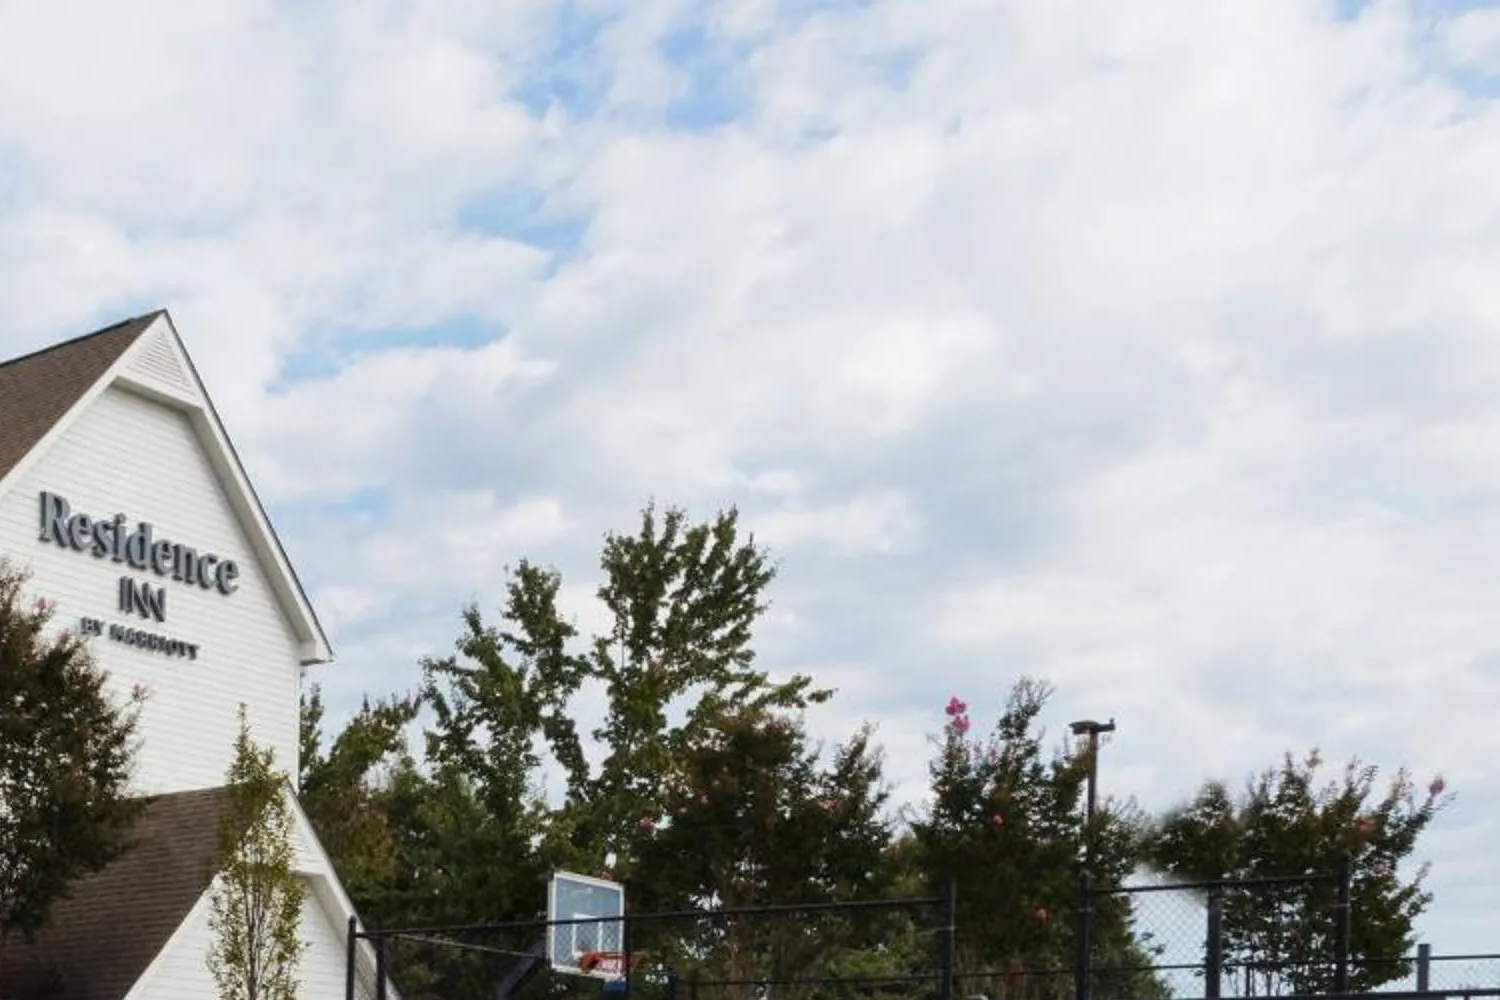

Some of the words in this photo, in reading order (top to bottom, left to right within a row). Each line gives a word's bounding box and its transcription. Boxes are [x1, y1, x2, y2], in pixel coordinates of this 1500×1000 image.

[38, 490, 240, 596] Residence
[118, 575, 166, 622] INN
[80, 617, 105, 637] BY
